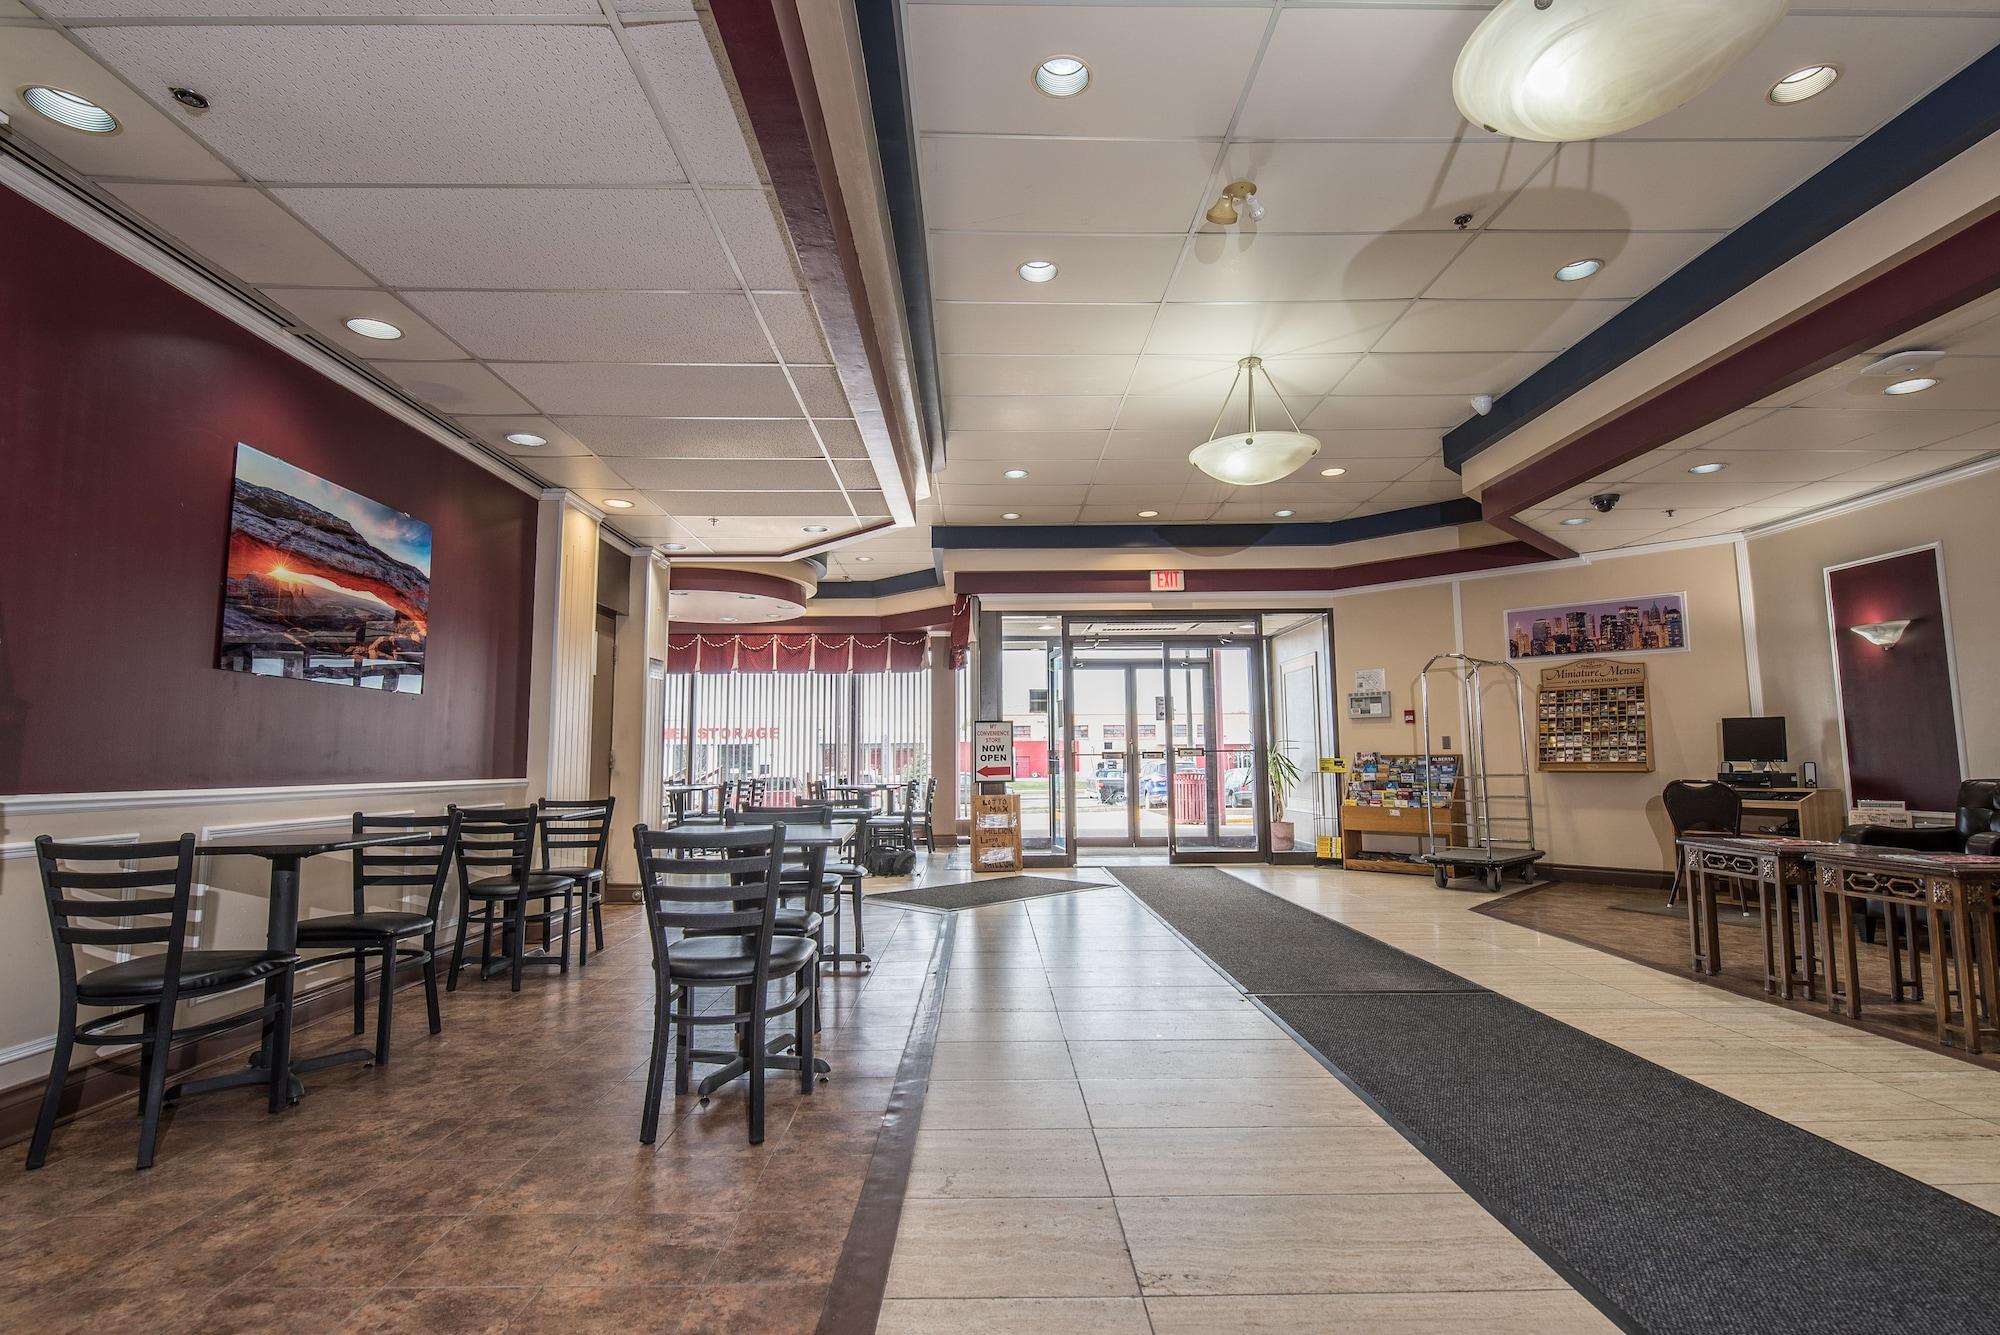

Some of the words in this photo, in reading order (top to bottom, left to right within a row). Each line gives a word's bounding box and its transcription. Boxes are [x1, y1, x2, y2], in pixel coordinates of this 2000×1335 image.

[1156, 571, 1179, 588] EXIT
[1546, 668, 1598, 680] Miniature
[1600, 665, 1640, 677] Menus
[697, 727, 780, 740] STORAGE
[989, 805, 1009, 813] MAX
